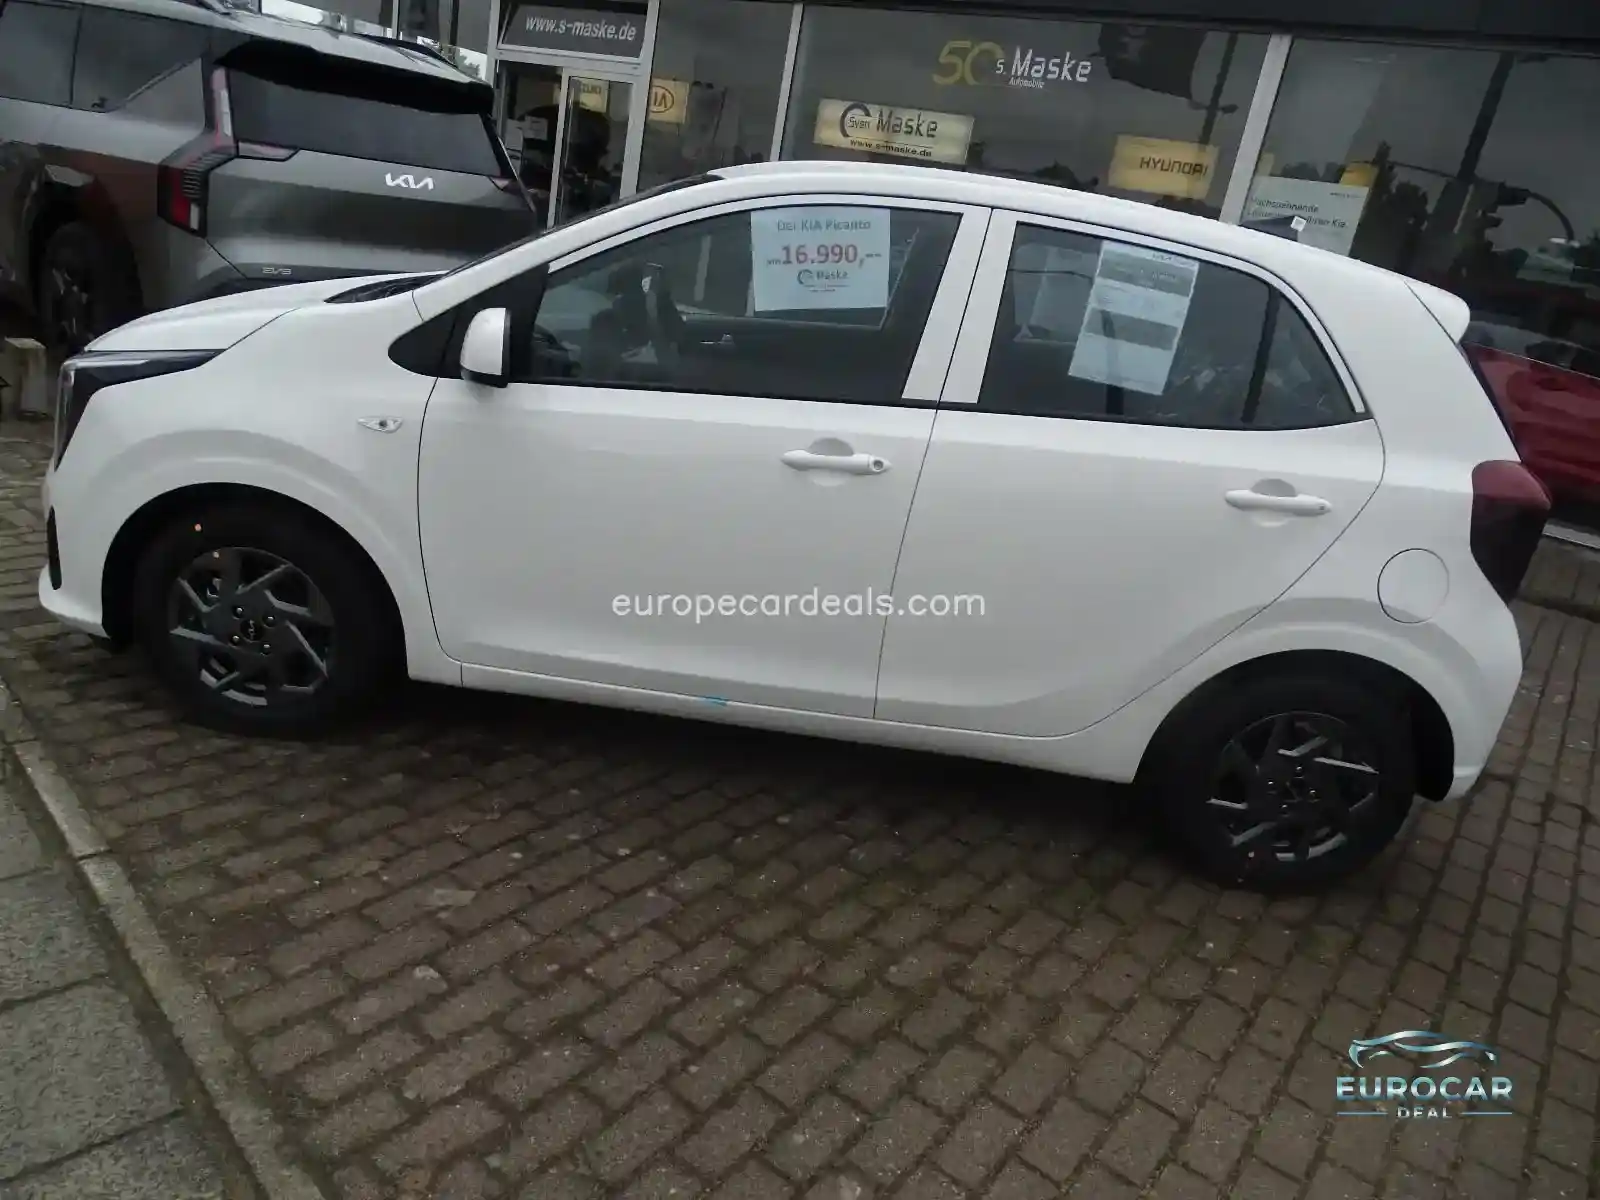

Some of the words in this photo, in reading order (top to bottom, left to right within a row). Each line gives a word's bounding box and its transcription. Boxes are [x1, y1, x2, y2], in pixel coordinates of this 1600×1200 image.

[525, 15, 637, 41] www.s-maske.de
[1010, 46, 1092, 82] Maske
[876, 109, 938, 138] Maske
[1140, 156, 1208, 176] HYUNDAI
[385, 172, 436, 191] KIA
[801, 218, 822, 232] KIA
[825, 219, 871, 231] Picanto
